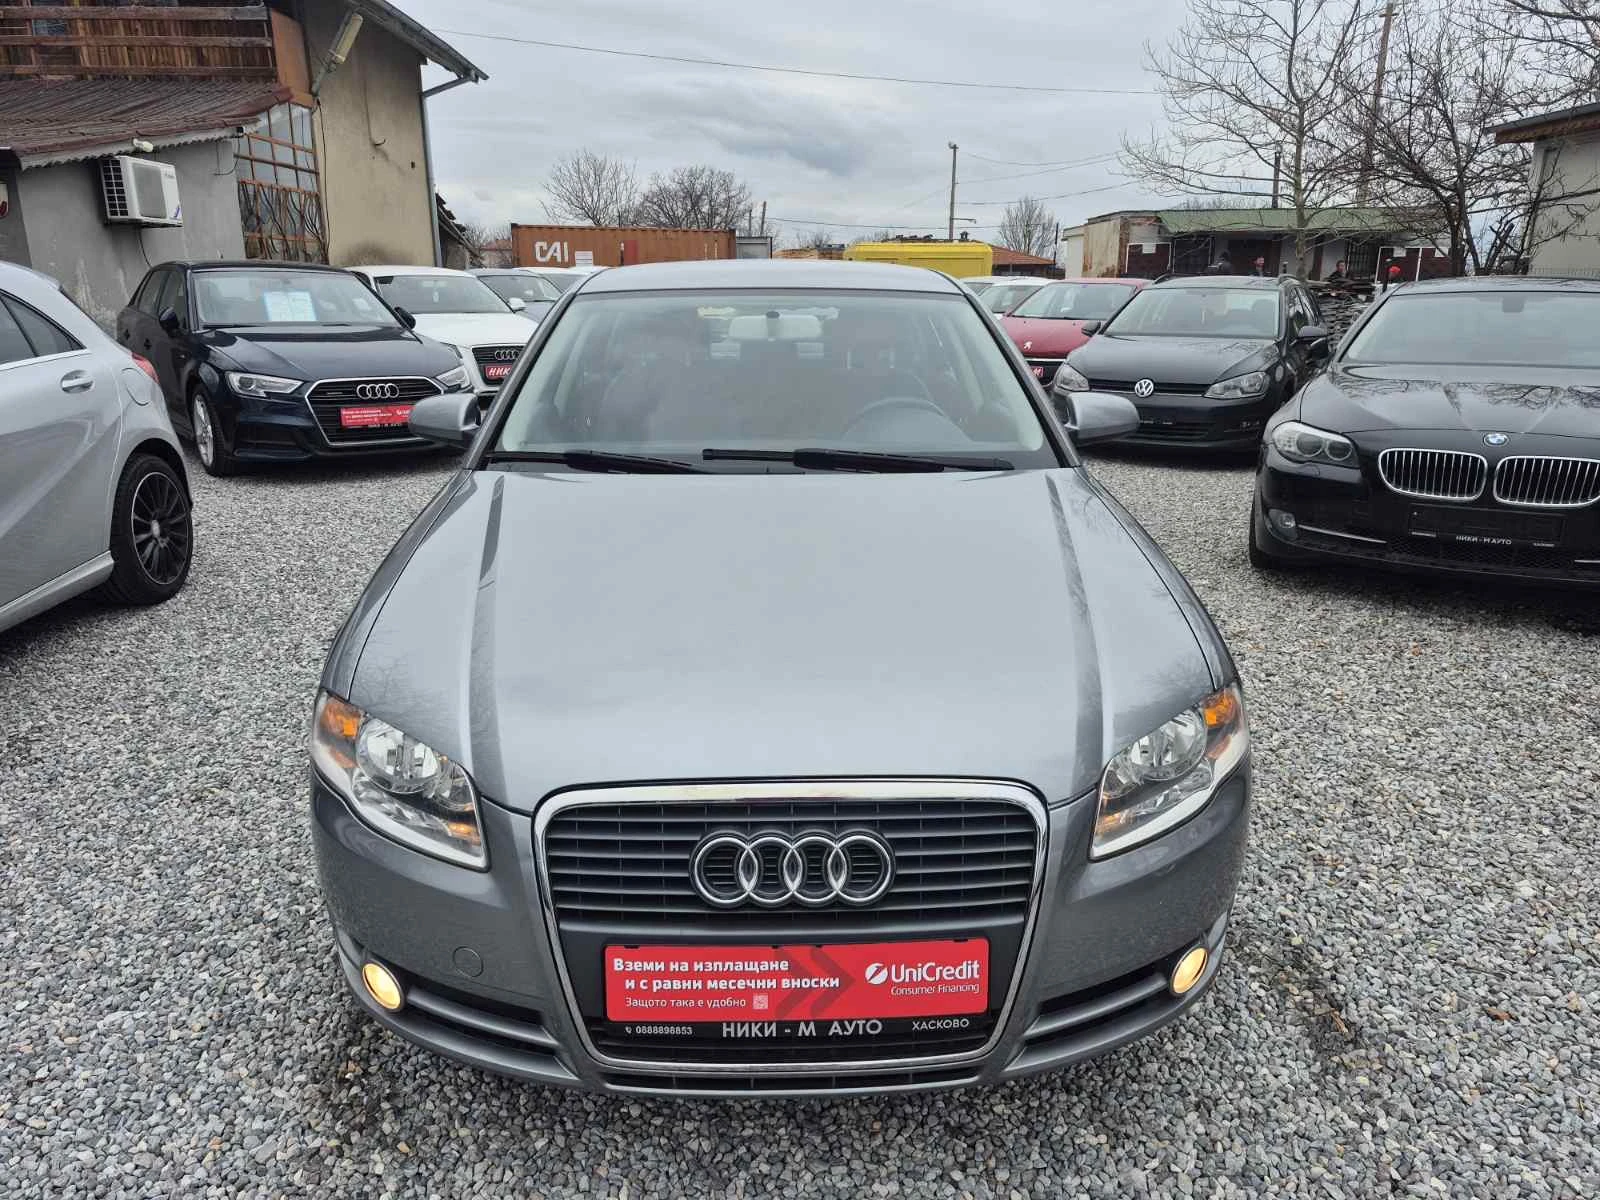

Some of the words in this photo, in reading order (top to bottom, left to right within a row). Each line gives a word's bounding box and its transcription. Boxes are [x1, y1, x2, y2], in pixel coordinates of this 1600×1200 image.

[535, 241, 569, 263] CAI
[1456, 535, 1478, 543] НИКИ
[613, 958, 665, 971] Вземи
[670, 961, 689, 971] на
[694, 960, 789, 973] изплащане
[891, 960, 980, 983] UniCredit
[625, 979, 635, 989] и
[640, 979, 648, 989] с
[653, 978, 703, 992] равни
[707, 978, 777, 989] месечни
[782, 977, 840, 989] вноски
[891, 985, 936, 996] Consumer
[938, 983, 980, 994] Financing
[625, 997, 667, 1008] Защото
[671, 998, 695, 1007] така
[697, 998, 704, 1007] е
[707, 996, 746, 1009] удобно
[635, 1025, 693, 1035] 0888898853
[722, 1022, 777, 1038] НИКИ
[798, 1022, 816, 1036] М
[828, 1019, 883, 1036] АУТО
[912, 1018, 969, 1031] ХАСКОВО
